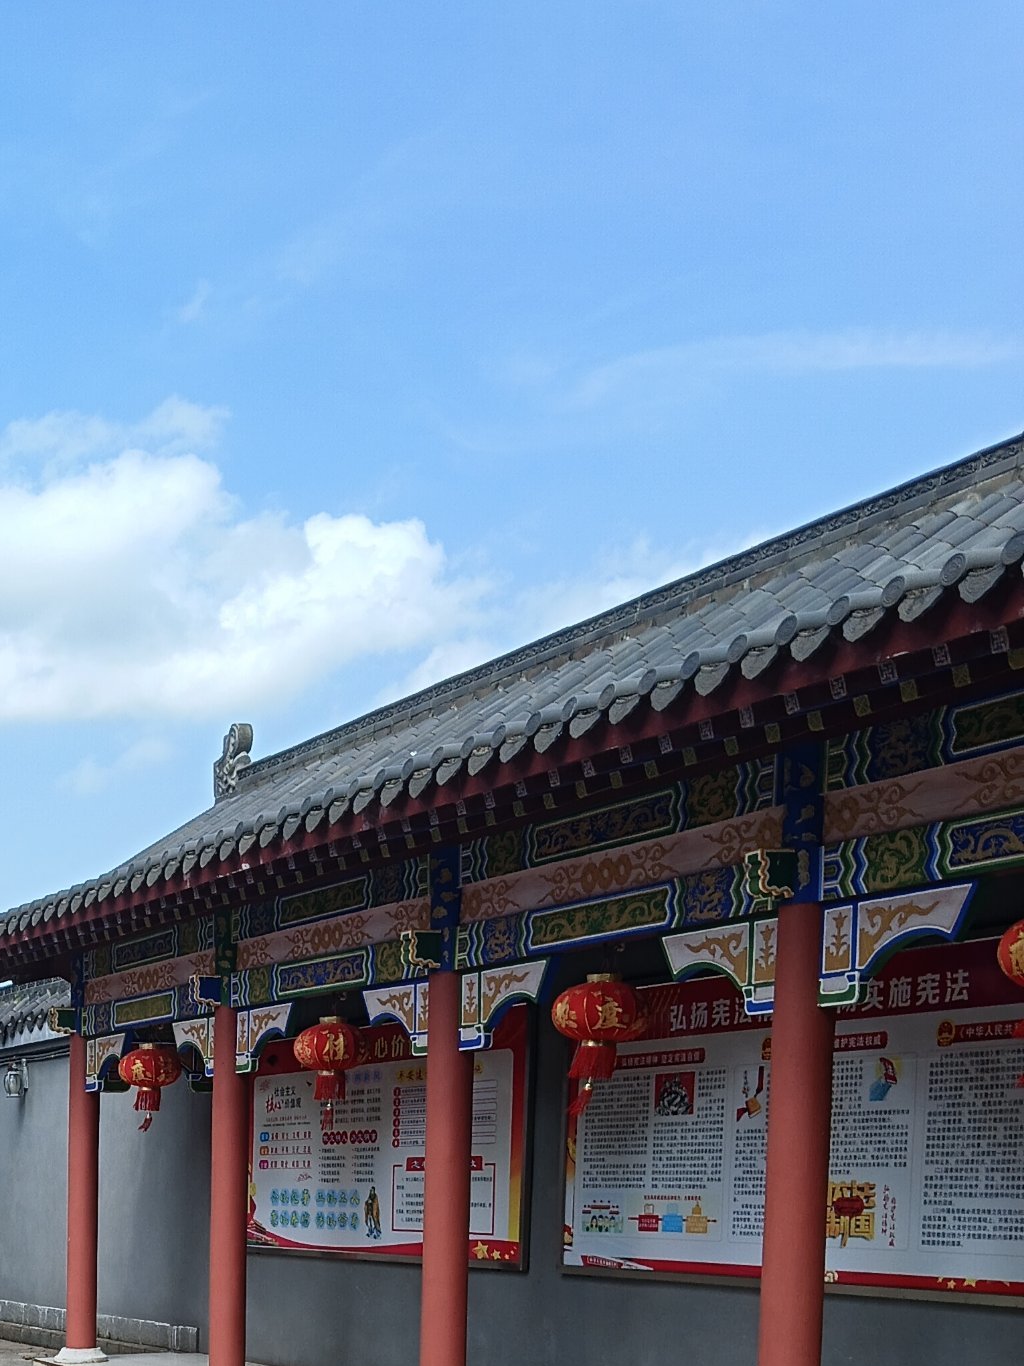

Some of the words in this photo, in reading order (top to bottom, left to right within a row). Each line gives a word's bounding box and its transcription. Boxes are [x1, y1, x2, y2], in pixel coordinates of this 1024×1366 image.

[670, 997, 773, 1032] 弘扬宪法
[959, 1023, 1019, 1038] 《中华人民共
[274, 1085, 296, 1097] 社会主义
